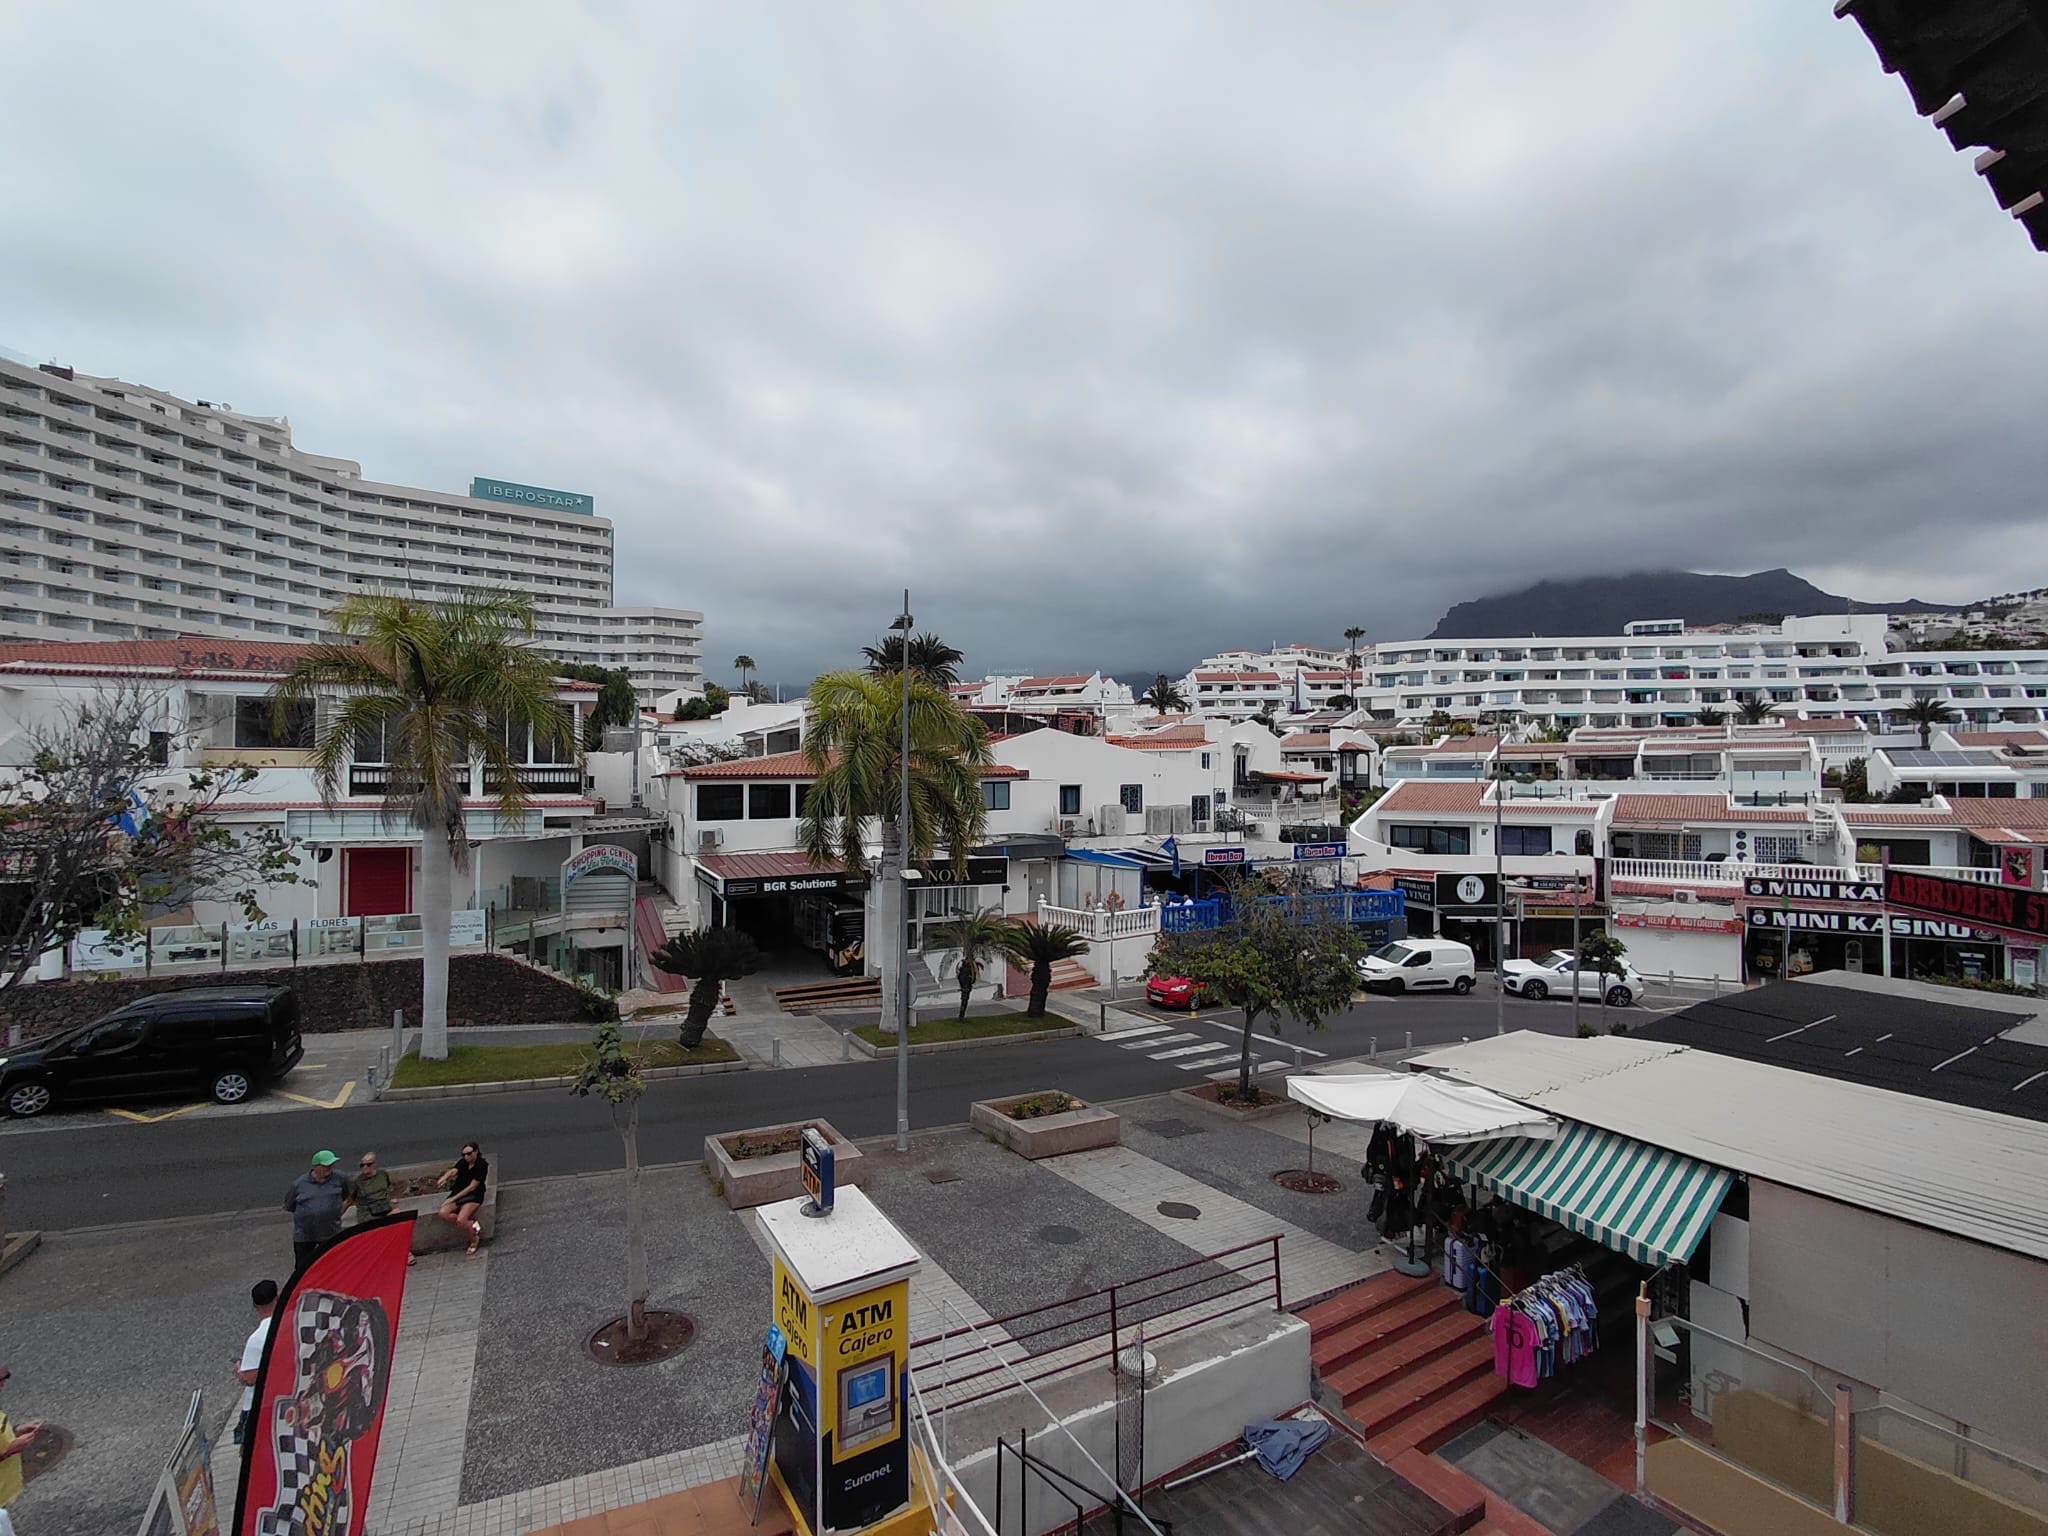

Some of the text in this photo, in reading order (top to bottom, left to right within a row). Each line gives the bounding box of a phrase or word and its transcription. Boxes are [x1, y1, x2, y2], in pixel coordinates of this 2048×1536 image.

[487, 485, 574, 507] IBEROSTAR
[180, 650, 235, 669] LAS
[572, 847, 607, 870] SHOPPING
[609, 847, 633, 863] CENTER
[1229, 851, 1242, 860] Bar
[763, 881, 787, 891] BGR
[790, 879, 838, 890] Solutions
[1768, 881, 1883, 900] MINI KA
[1888, 873, 2016, 924] ABERDEEN
[257, 918, 349, 931] LAS FLORES
[1647, 916, 1667, 925] RENT
[1671, 918, 1677, 926] A
[1680, 919, 1726, 929] MOTORBIKE
[1772, 911, 1840, 930] MINI
[803, 1165, 820, 1196] ATM
[782, 1275, 807, 1330] ATM
[841, 1300, 892, 1335] ATM
[781, 1306, 808, 1359] Cajero
[838, 1328, 893, 1356] Cajero
[844, 1464, 893, 1491] Euronet
